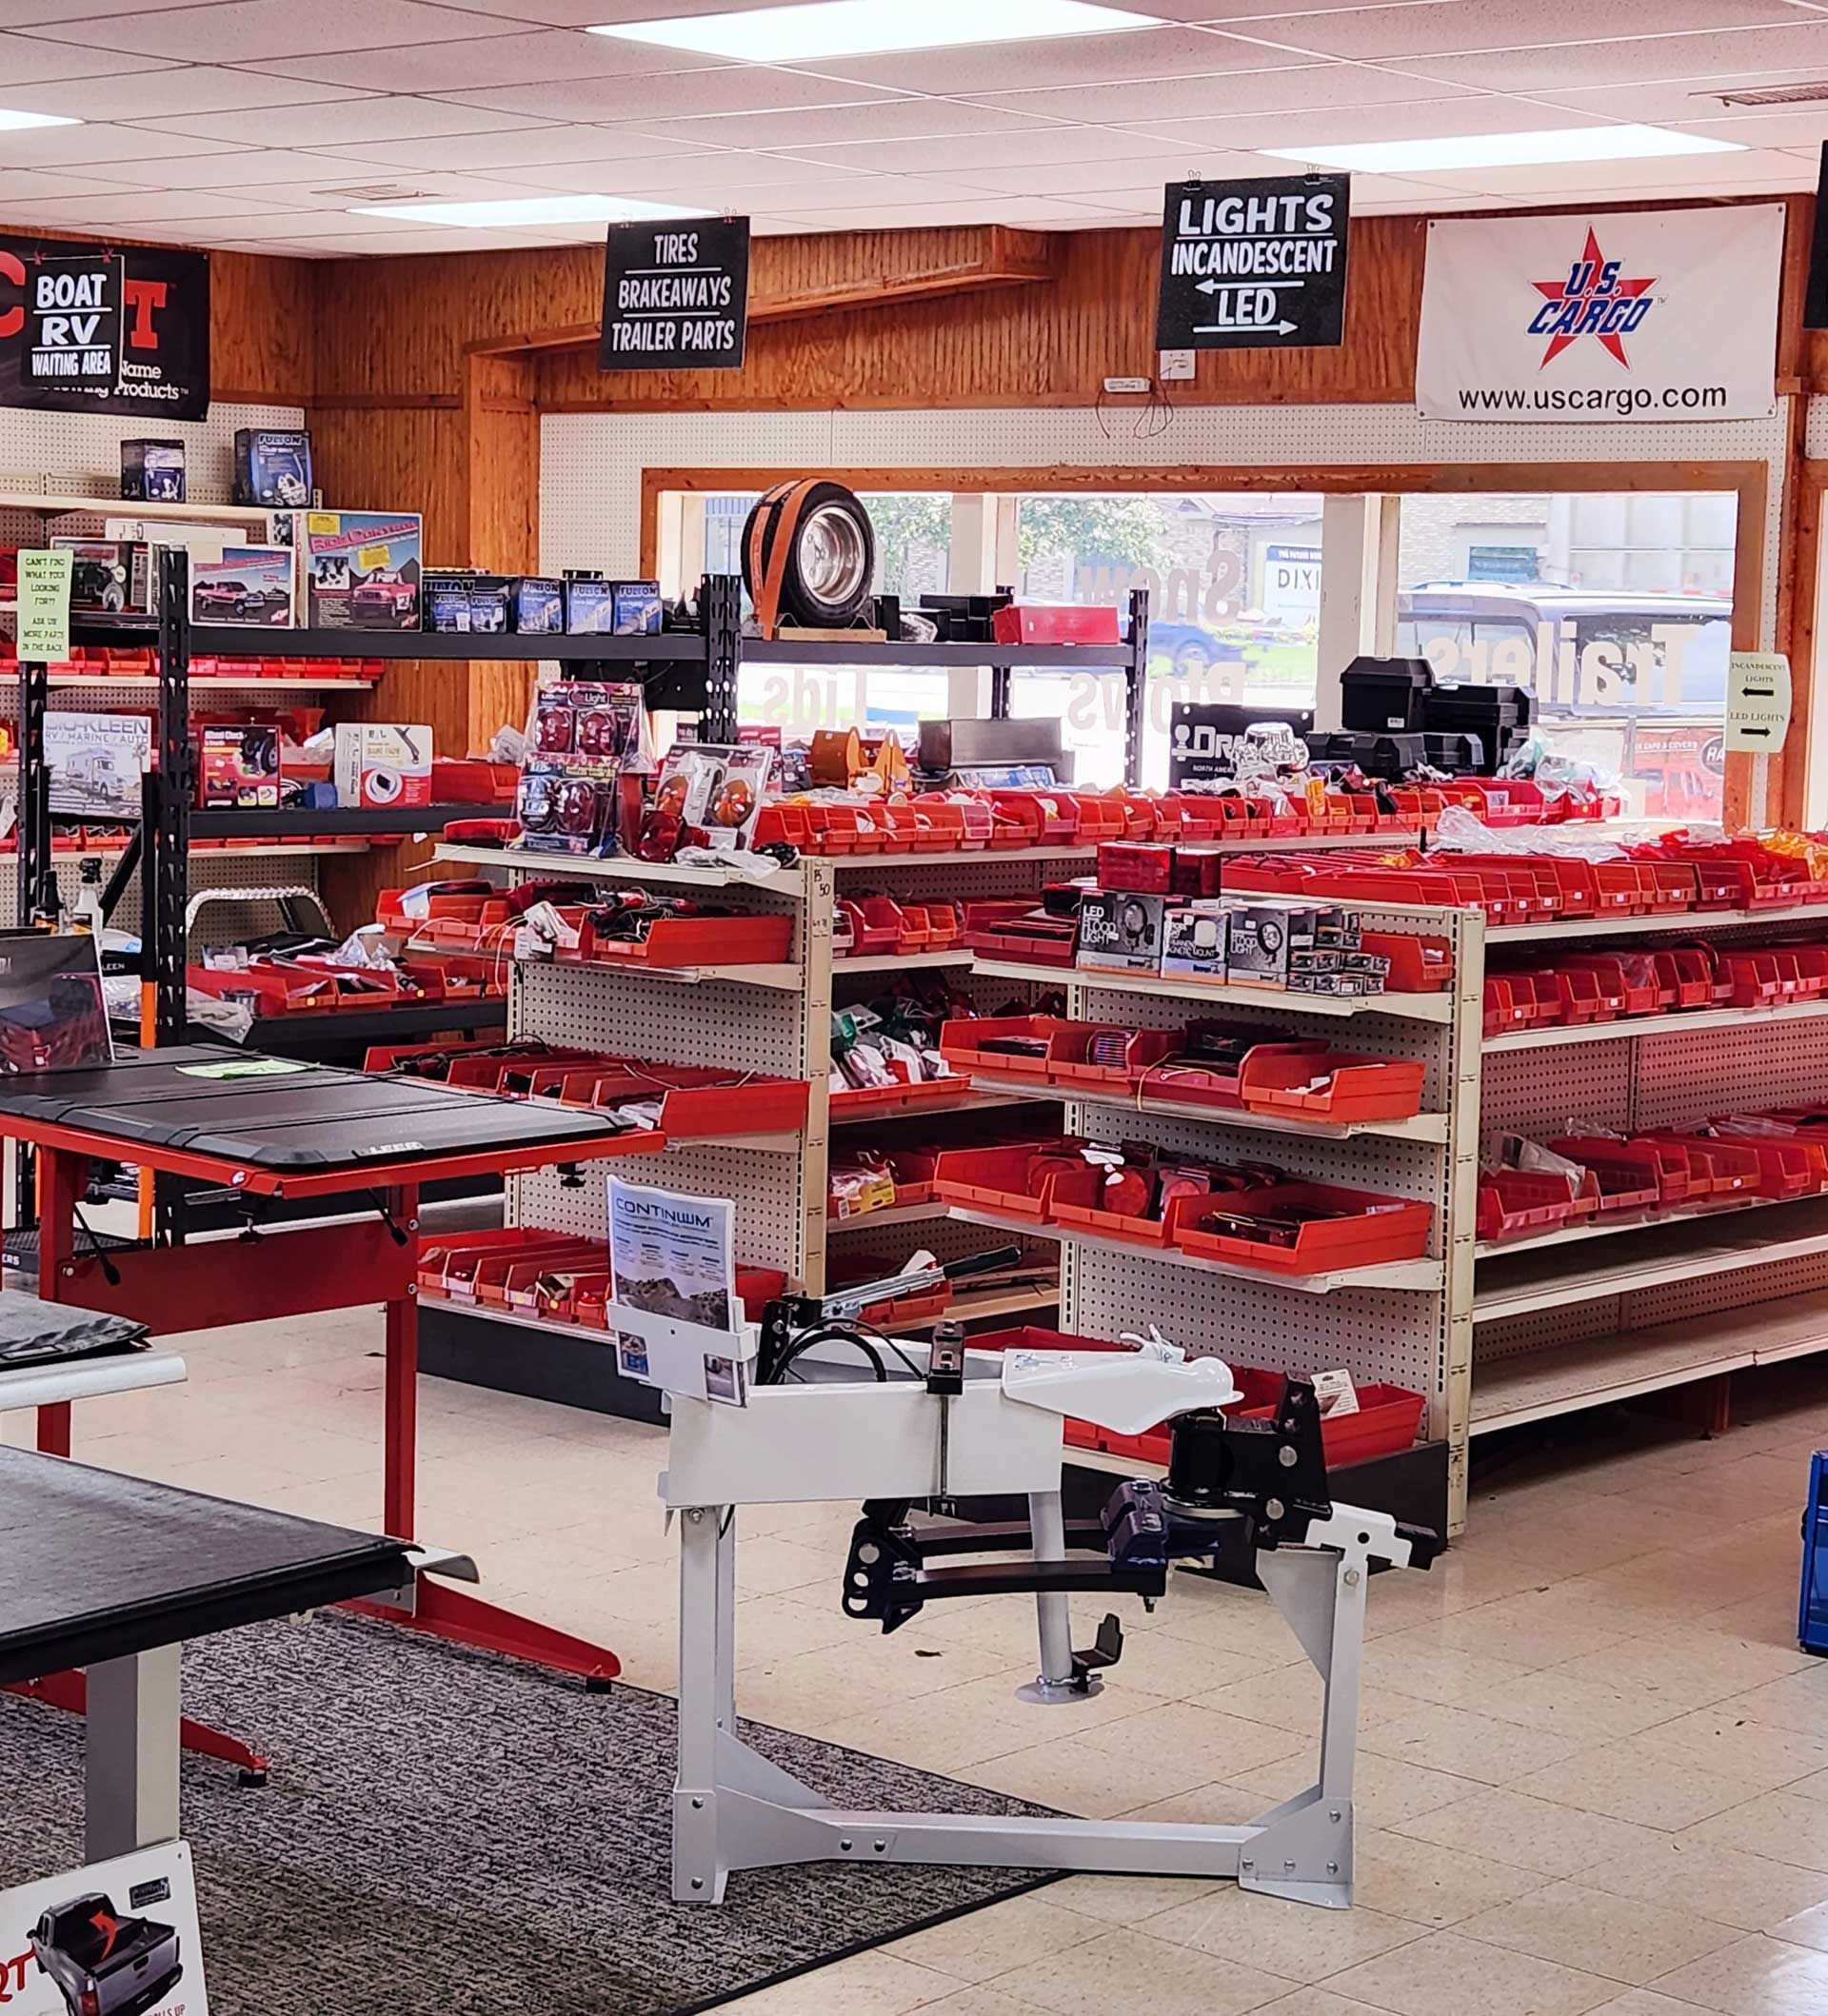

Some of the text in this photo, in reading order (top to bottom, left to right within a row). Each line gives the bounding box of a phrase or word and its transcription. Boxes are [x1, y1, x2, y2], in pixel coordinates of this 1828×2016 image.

[1179, 194, 1334, 235] LIGHTS
[654, 233, 699, 264] TIRES
[1171, 240, 1338, 275] INCANDESCENT
[37, 273, 108, 308] BOAT
[618, 276, 731, 309] BRAKEAWAYS
[1564, 261, 1622, 297] U.S.
[1218, 288, 1277, 326] LED
[1526, 297, 1655, 335] CARGO
[42, 315, 101, 346] RV
[611, 320, 735, 351] TRAILER PARTS
[31, 351, 111, 376] WAITING AREA
[122, 360, 163, 379] Name
[1459, 385, 1727, 415] www.uscargo.com
[30, 583, 61, 592] LOOKING
[1729, 712, 1785, 721] LED LIGHTS
[68, 733, 109, 742] MARINE
[120, 735, 149, 744] AUTO
[819, 883, 830, 897] 50
[1083, 904, 1104, 918] LED
[617, 1197, 711, 1228] CONTINUUM
